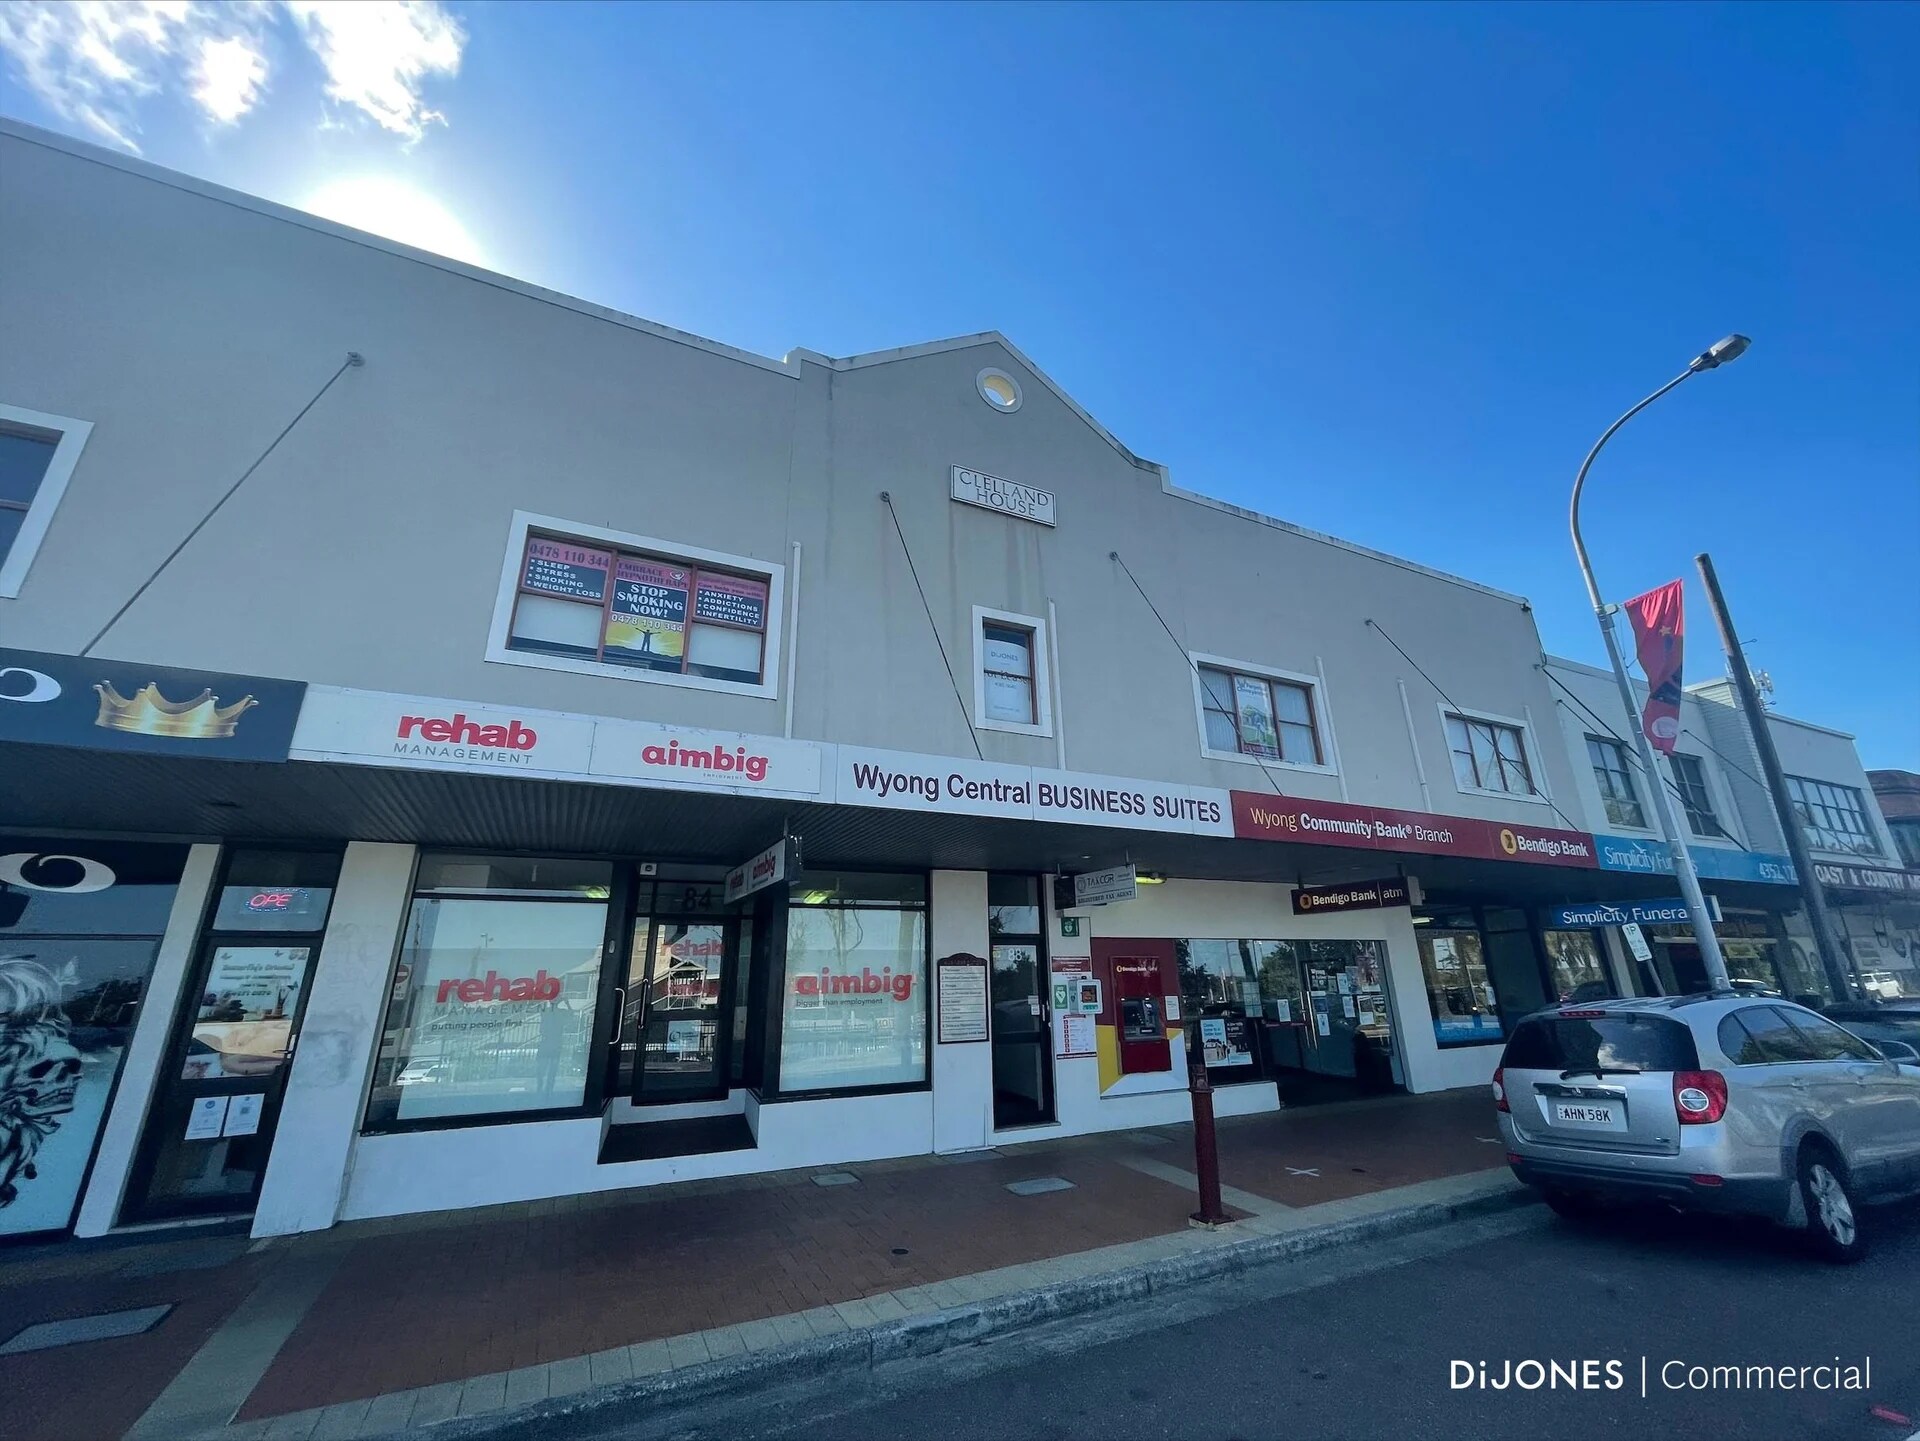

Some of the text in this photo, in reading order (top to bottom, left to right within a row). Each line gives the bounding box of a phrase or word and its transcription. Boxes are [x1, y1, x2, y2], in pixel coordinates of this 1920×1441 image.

[959, 471, 1049, 506] CLELLAND
[976, 488, 1035, 517] HOUSE
[530, 543, 609, 568] 0478 110 344
[536, 567, 576, 579] STRESS
[537, 560, 570, 570] SLEEP
[534, 573, 584, 588] SMOKING
[533, 581, 601, 598] WEIGHT LOSS
[630, 583, 668, 598] STOP
[704, 590, 744, 602] ANXIETY
[617, 591, 683, 611] SMOKING
[703, 597, 758, 612] ADDICTIONS
[630, 604, 668, 618] NOW!
[702, 610, 758, 625] INFERTILITY
[703, 604, 760, 619] CONFIDENCE
[611, 614, 683, 632] 0478 110 344
[398, 713, 537, 751] rehab
[393, 742, 533, 764] MANAGEMENT
[642, 740, 769, 781] aimbig
[853, 762, 1221, 823] Wyong Central BUSINESS SUITES
[1250, 807, 1298, 832] Wyong
[1300, 813, 1372, 839] Community
[1415, 825, 1453, 843] Branch
[1517, 835, 1589, 857] Bendigo Bank
[1604, 846, 1655, 872] Simplicity
[1814, 864, 1846, 884] OAST
[684, 887, 712, 911] 84
[1312, 888, 1403, 905] Bendigo Bank atm
[1562, 907, 1688, 925] Simplicity Funera
[660, 939, 725, 956] rehab
[1008, 948, 1023, 962] 88
[437, 970, 561, 1003] rehab
[796, 967, 913, 1001] aimbig
[433, 1003, 559, 1016] MANAGEMENT
[796, 999, 820, 1008] bigger
[431, 1022, 467, 1031] putting
[470, 1020, 502, 1030] people
[1564, 1107, 1612, 1122] AHN 58K
